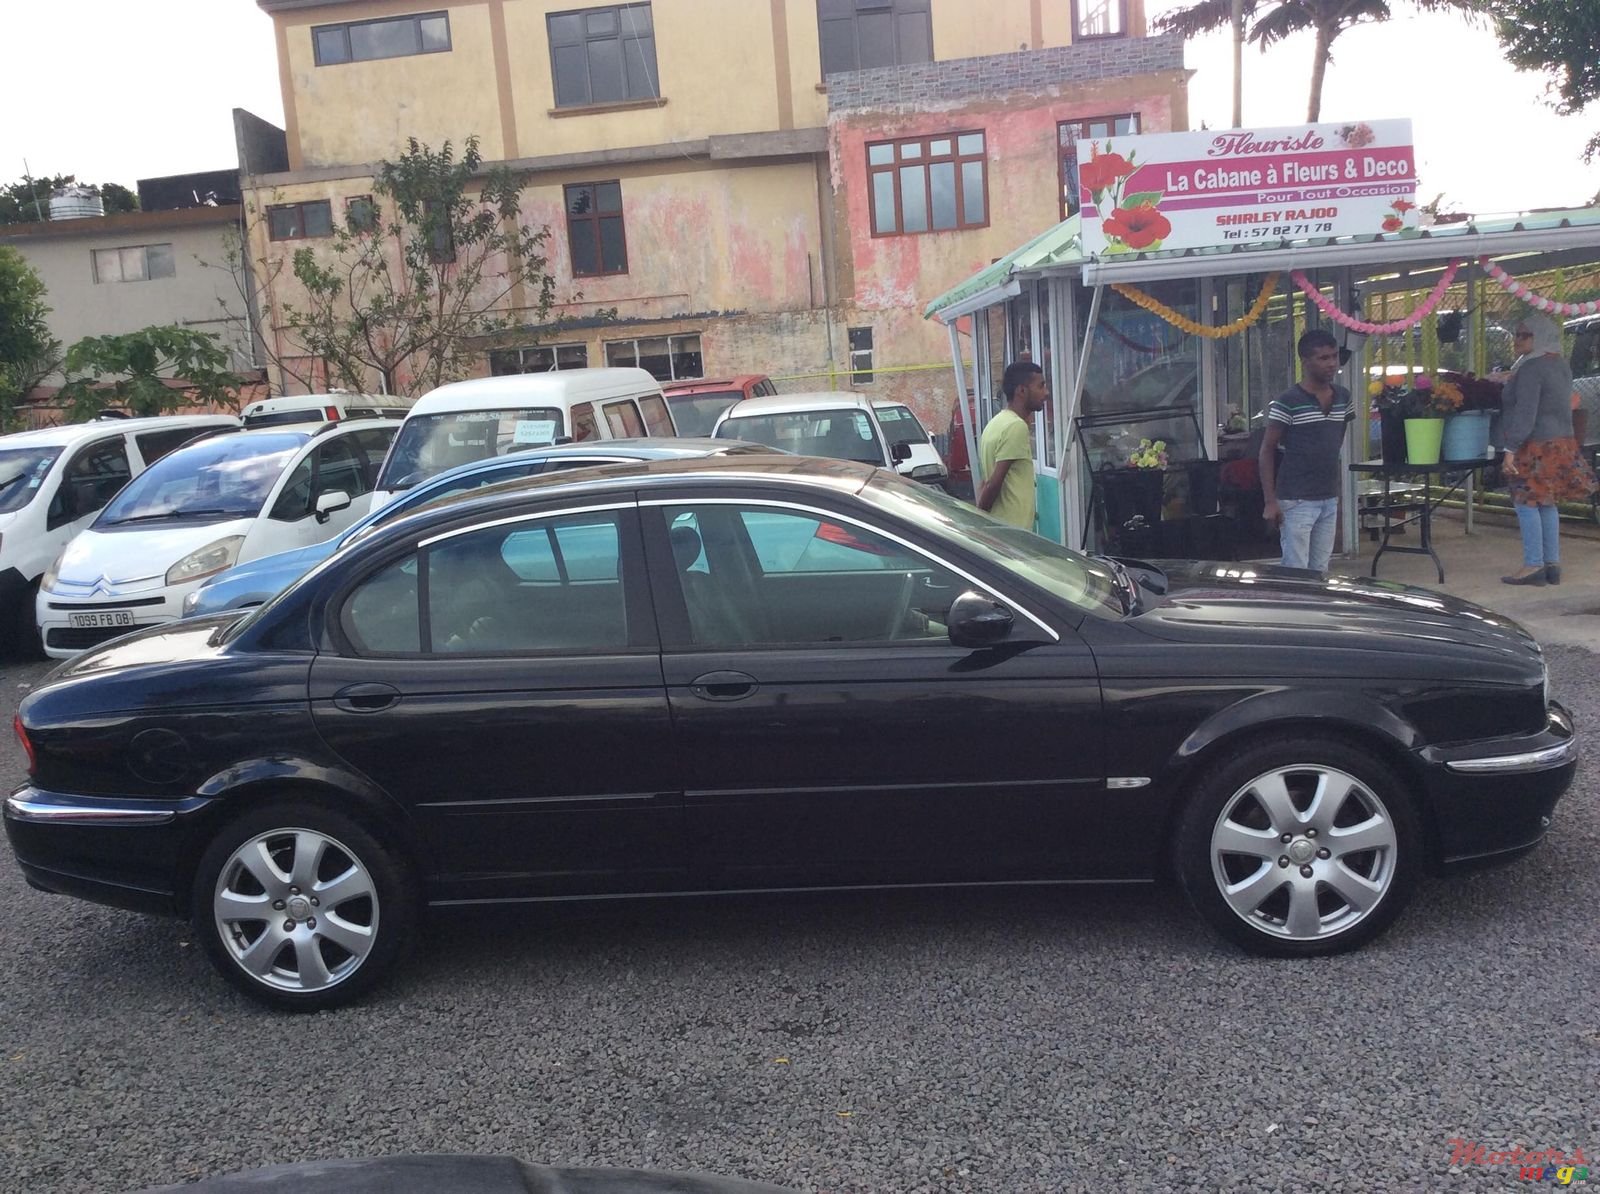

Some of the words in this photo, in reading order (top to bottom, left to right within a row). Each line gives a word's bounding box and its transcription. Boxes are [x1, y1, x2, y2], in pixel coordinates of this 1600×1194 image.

[1207, 130, 1324, 157] Fleuriste
[1166, 171, 1189, 192] La
[1194, 167, 1261, 190] Cabane
[1267, 163, 1278, 185] à
[1283, 161, 1339, 183] Fleurs
[1344, 158, 1358, 179] &
[1363, 156, 1408, 177] Deco
[1257, 193, 1293, 203] Pour
[1298, 188, 1332, 200] Tout
[1335, 184, 1410, 197] Occasion
[1216, 210, 1281, 226] SHIRLEY
[1285, 206, 1338, 220] RAJOO
[1251, 227, 1270, 237] 57
[1272, 224, 1291, 236] 82
[1294, 224, 1309, 234] 71
[1315, 222, 1333, 232] 78
[74, 615, 98, 627] 1099
[116, 613, 129, 624] 08
